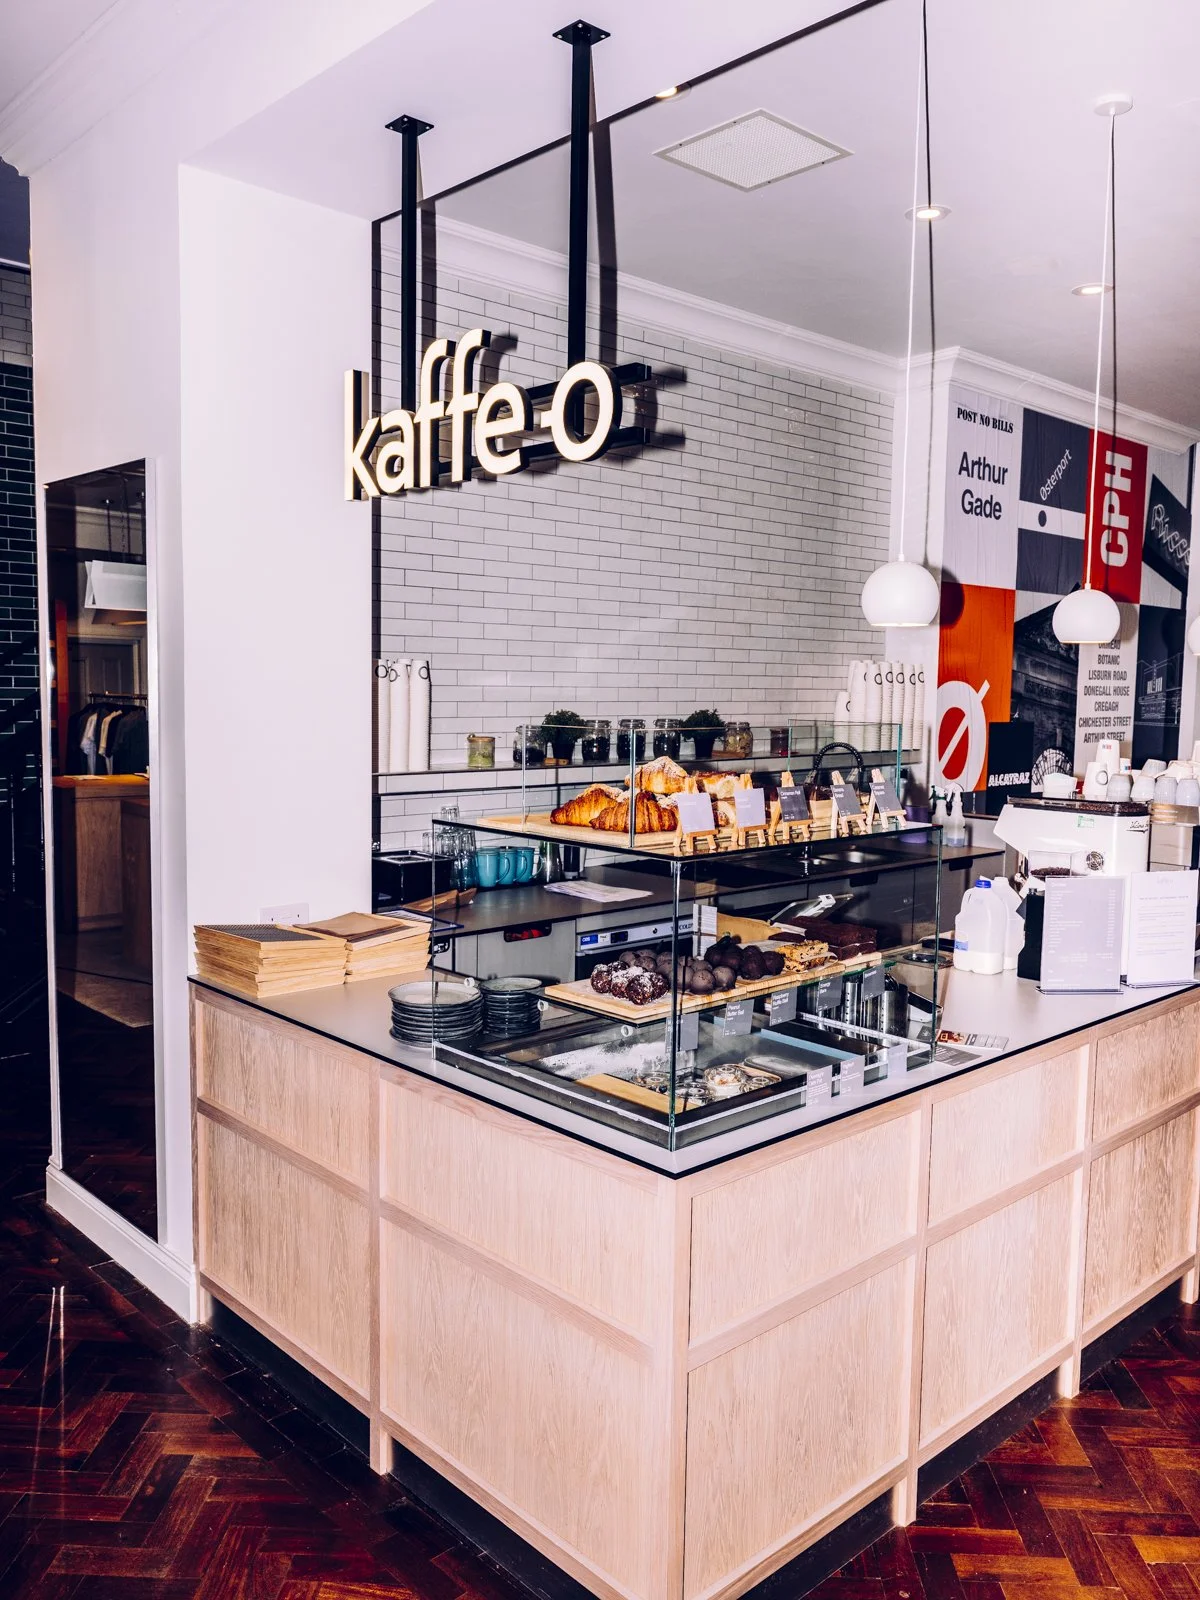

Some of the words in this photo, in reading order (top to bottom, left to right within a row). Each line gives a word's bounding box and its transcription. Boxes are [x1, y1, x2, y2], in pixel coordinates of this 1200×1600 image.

[957, 407, 977, 424] POST
[979, 413, 990, 427] NO
[992, 417, 1013, 434] BILLS
[958, 451, 1008, 485] Arthur
[1039, 449, 1072, 501] Østerport
[961, 488, 1002, 521] Gade
[1100, 450, 1132, 567] CPH
[1098, 654, 1120, 665] BOTANIC
[1088, 670, 1111, 680] LISBURN
[1113, 671, 1127, 681] ROAD
[1083, 686, 1111, 696] DONEGALL
[1113, 686, 1130, 697] HOUSE
[1094, 701, 1119, 711] CREGAGH
[1078, 717, 1112, 728] CHICHESTER
[1113, 716, 1131, 727] STREET
[988, 772, 1030, 787] ALCATRAZ
